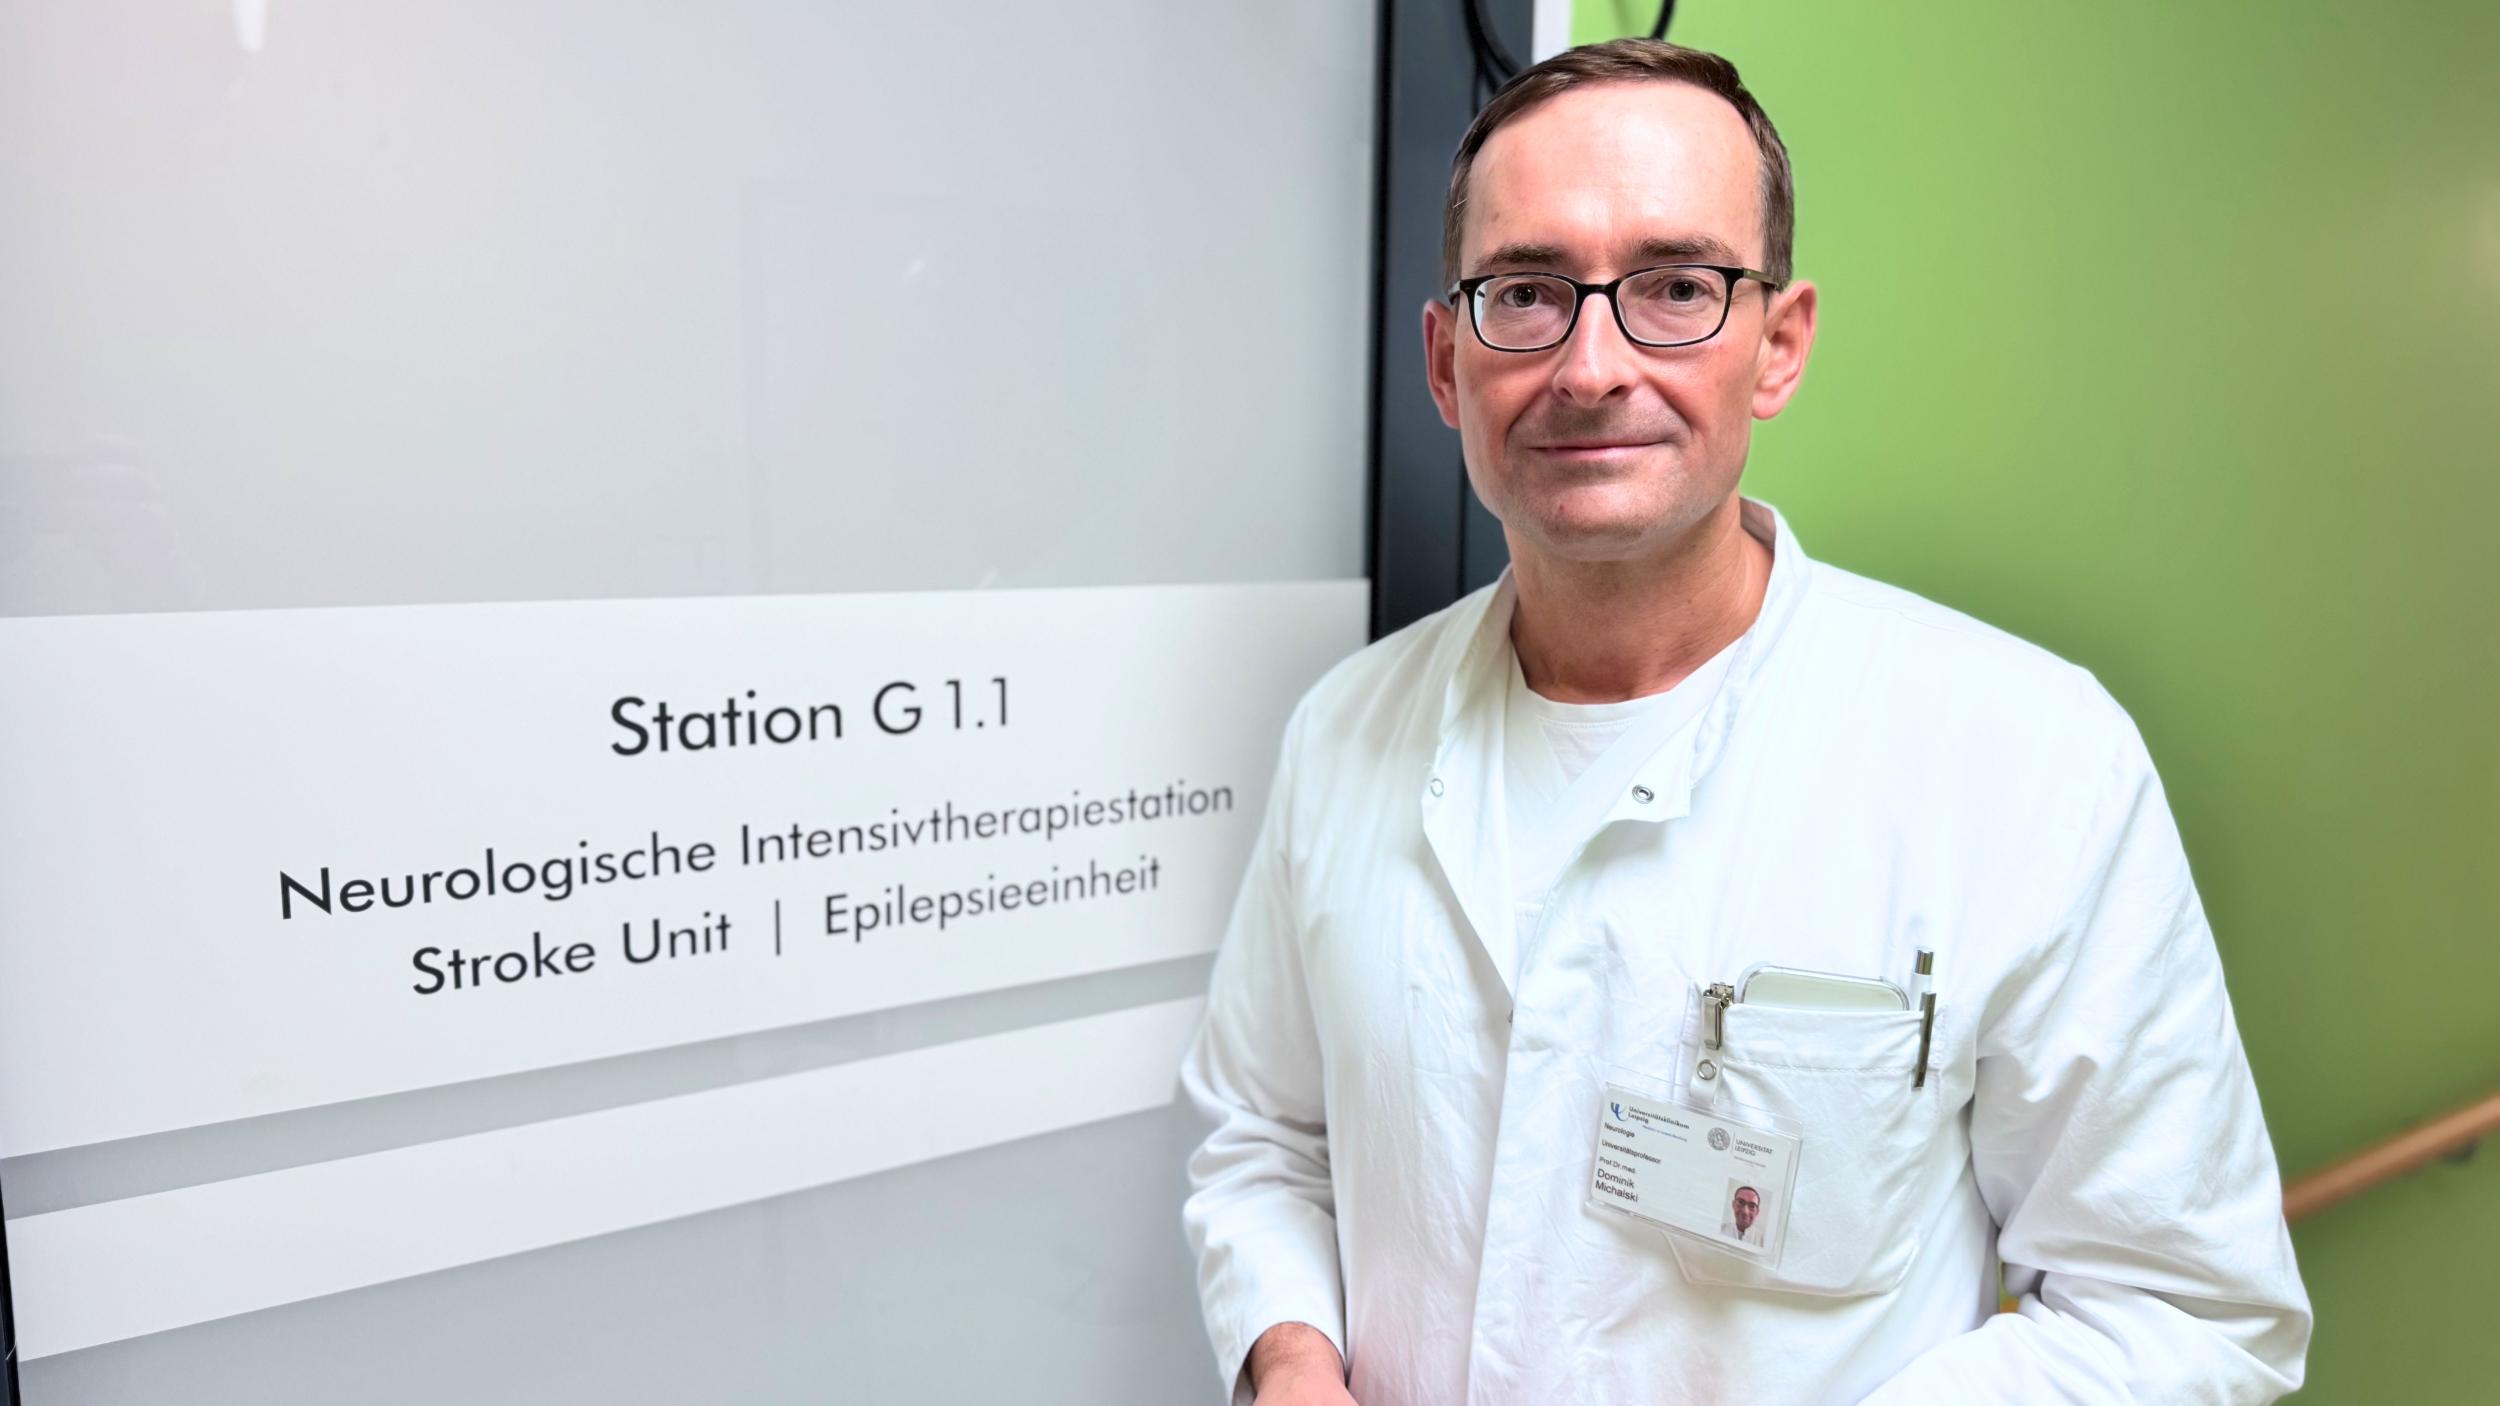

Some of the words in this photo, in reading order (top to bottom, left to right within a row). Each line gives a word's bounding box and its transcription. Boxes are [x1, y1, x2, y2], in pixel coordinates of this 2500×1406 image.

[610, 688, 843, 757] Station
[872, 680, 923, 736] G
[279, 830, 717, 920] Neurologische
[741, 786, 1234, 866] Intensivtherapiestation
[412, 930, 596, 996] Stroke
[622, 910, 732, 965] Unit
[825, 858, 1160, 944] Epilepsieeinheit
[1595, 1179, 1639, 1203] Michalski
[1597, 1168, 1635, 1189] Dominik
